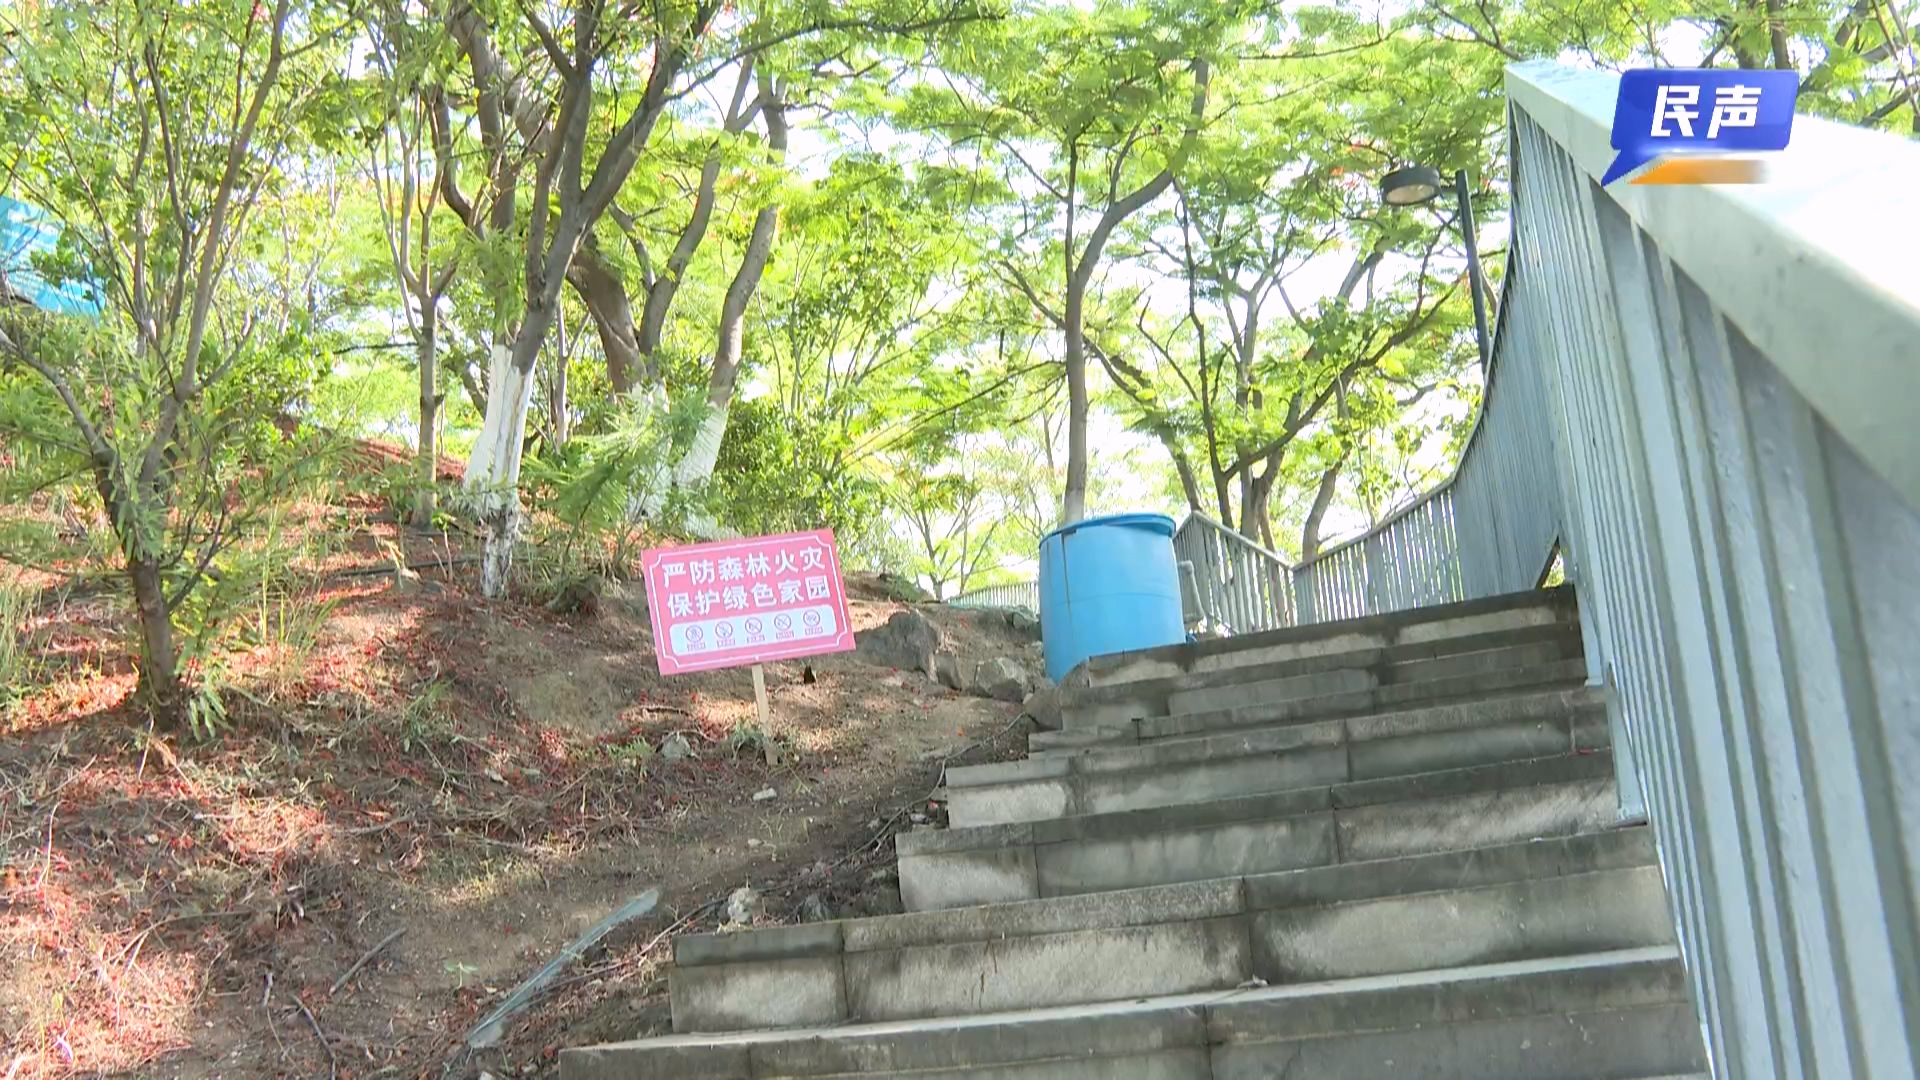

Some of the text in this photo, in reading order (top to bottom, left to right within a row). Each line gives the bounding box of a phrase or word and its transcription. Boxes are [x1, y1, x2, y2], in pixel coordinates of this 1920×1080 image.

[661, 546, 826, 588] 严防森林火灾
[667, 574, 831, 618] 保护绿色家园
